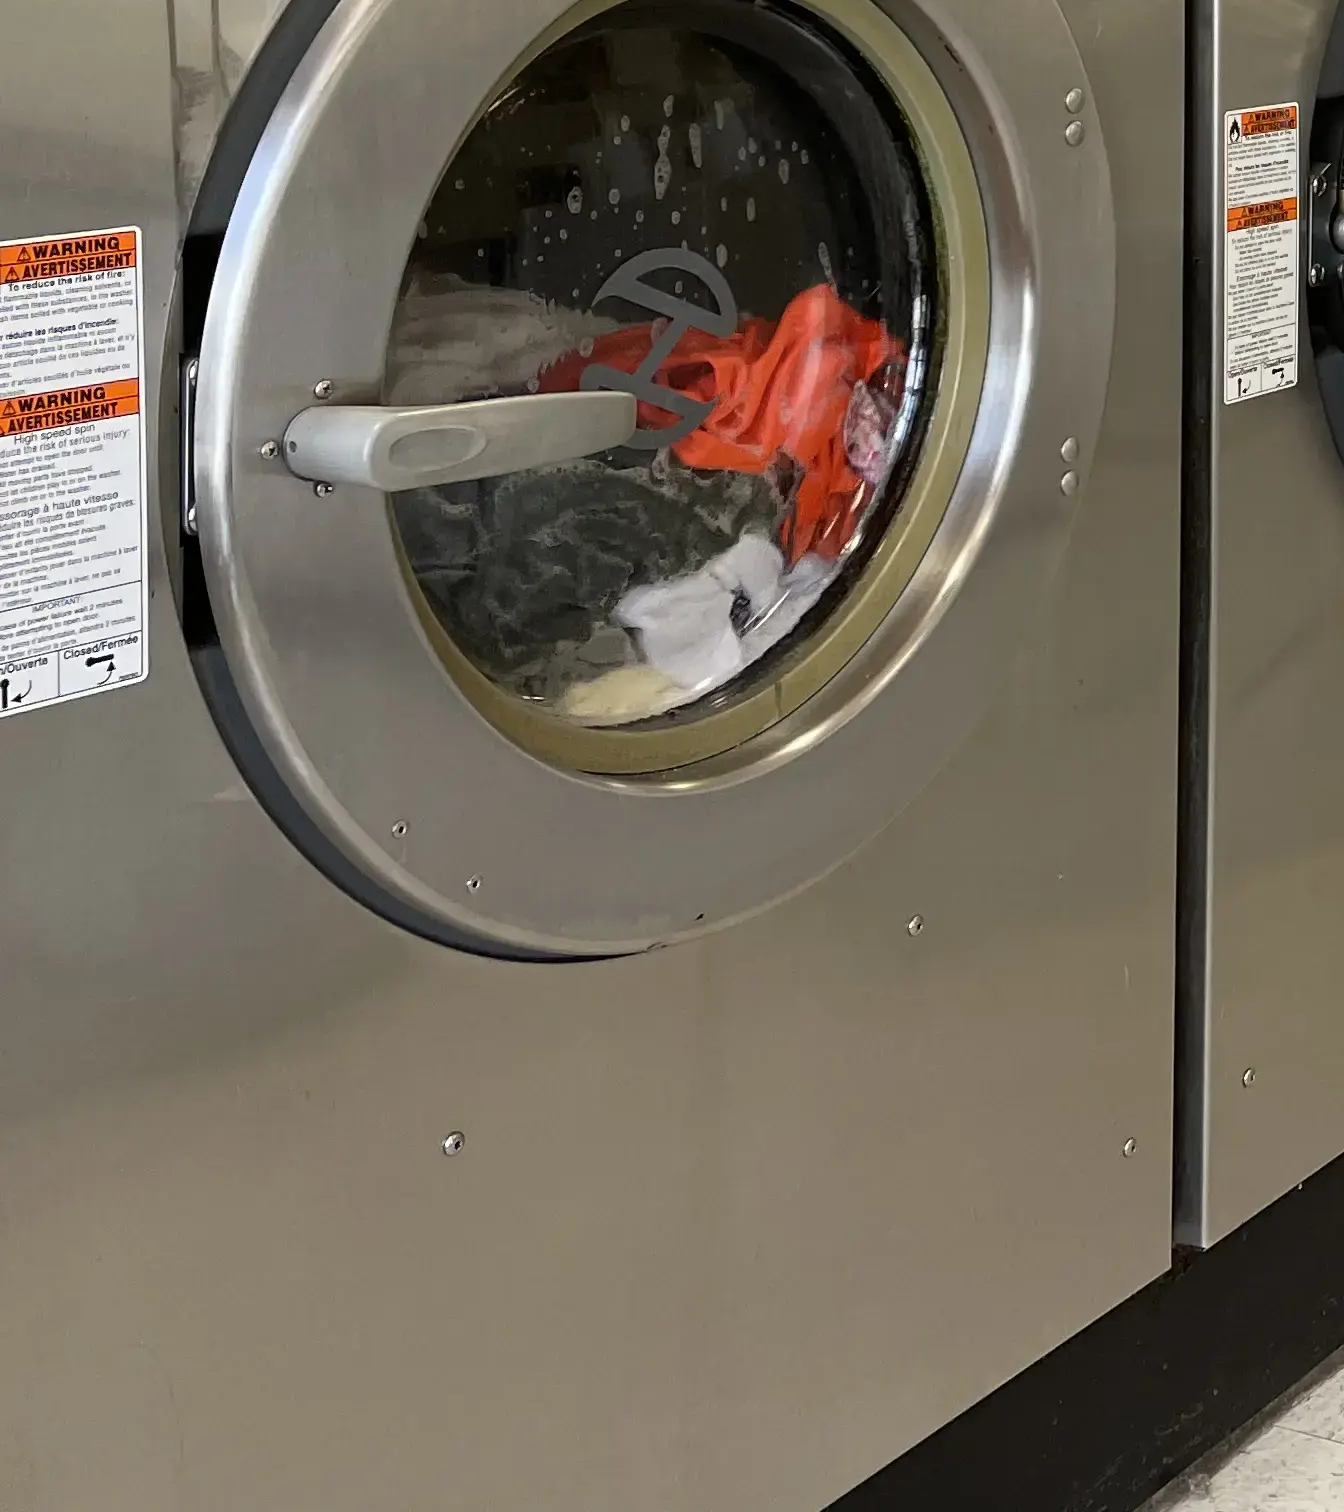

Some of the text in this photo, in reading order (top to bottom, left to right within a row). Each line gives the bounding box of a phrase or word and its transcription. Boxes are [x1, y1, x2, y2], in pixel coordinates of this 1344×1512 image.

[33, 236, 119, 259] WARNING
[23, 252, 132, 278] AVERTISSEMENT
[8, 271, 125, 291] To reduce the risk of fire:
[48, 323, 76, 334] risques
[18, 387, 105, 413] WARNING
[8, 402, 118, 433] AVERTISSEMENT
[14, 424, 95, 445] High speed spin
[0, 448, 21, 458] duce
[24, 446, 36, 454] the
[40, 442, 55, 451] risk
[59, 439, 66, 448] of
[69, 435, 100, 446] serious
[0, 507, 40, 521] ssorage
[43, 504, 49, 513] à
[53, 499, 81, 510] haute
[64, 635, 138, 660] Closed/Fermée
[0, 657, 48, 674] n/Ouverte
